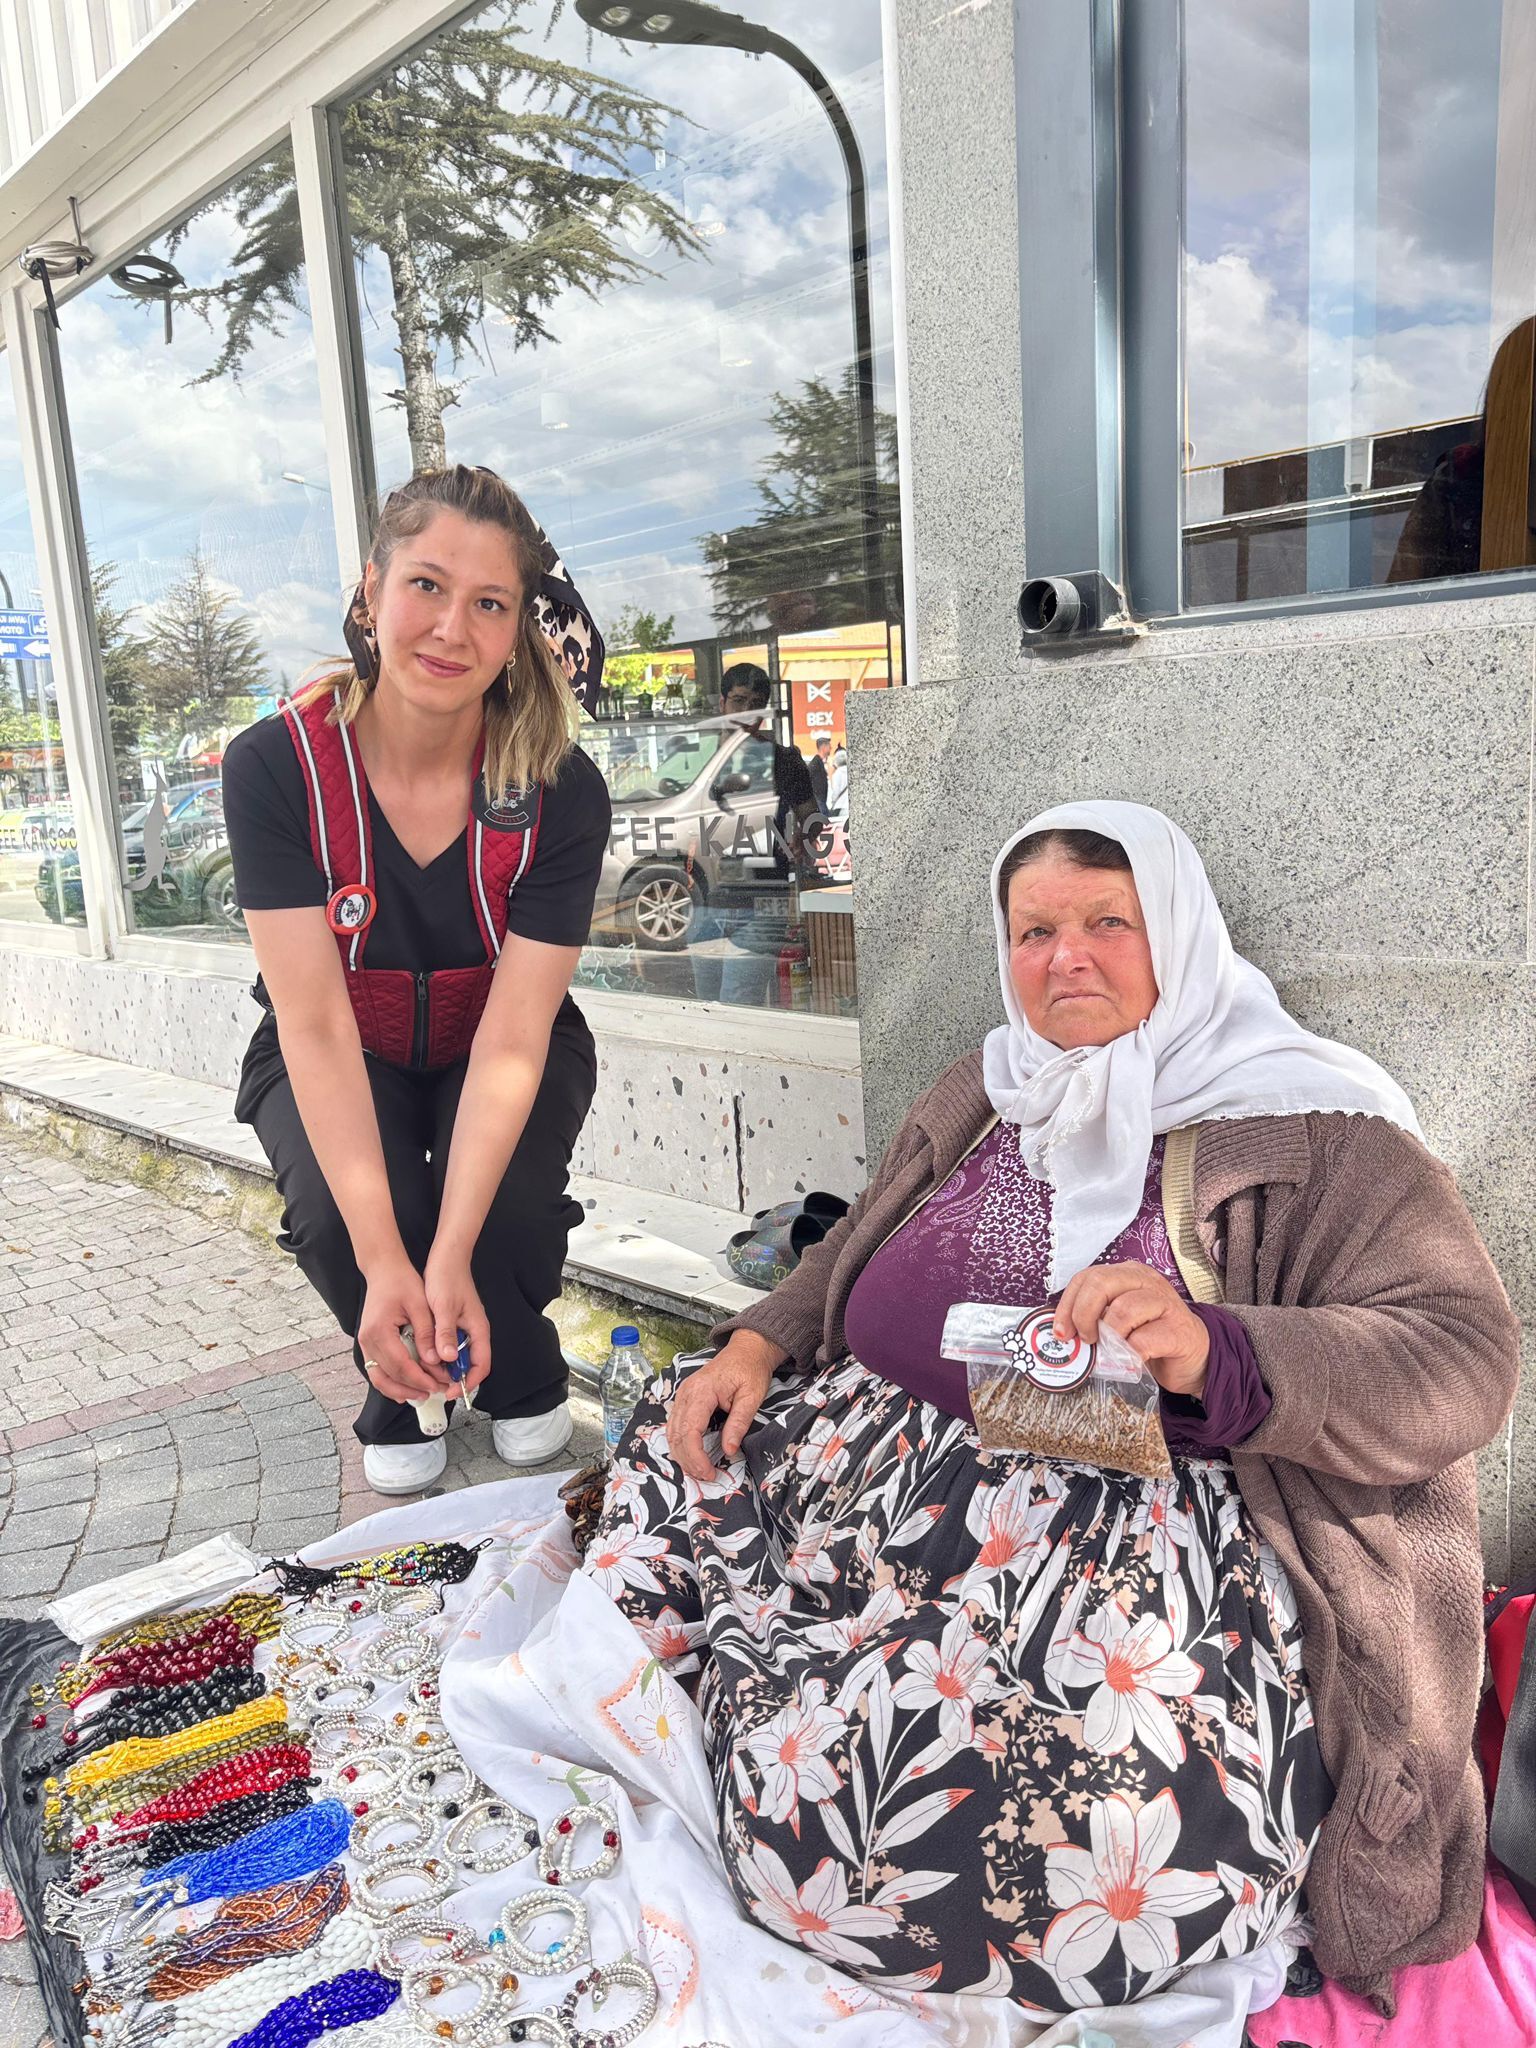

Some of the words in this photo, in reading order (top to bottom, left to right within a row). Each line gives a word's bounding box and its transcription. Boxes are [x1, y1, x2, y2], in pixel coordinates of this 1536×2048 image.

[806, 711, 834, 727] BEX
[181, 822, 227, 849] COFF
[608, 816, 678, 857] FEE
[699, 812, 850, 860] KANG
